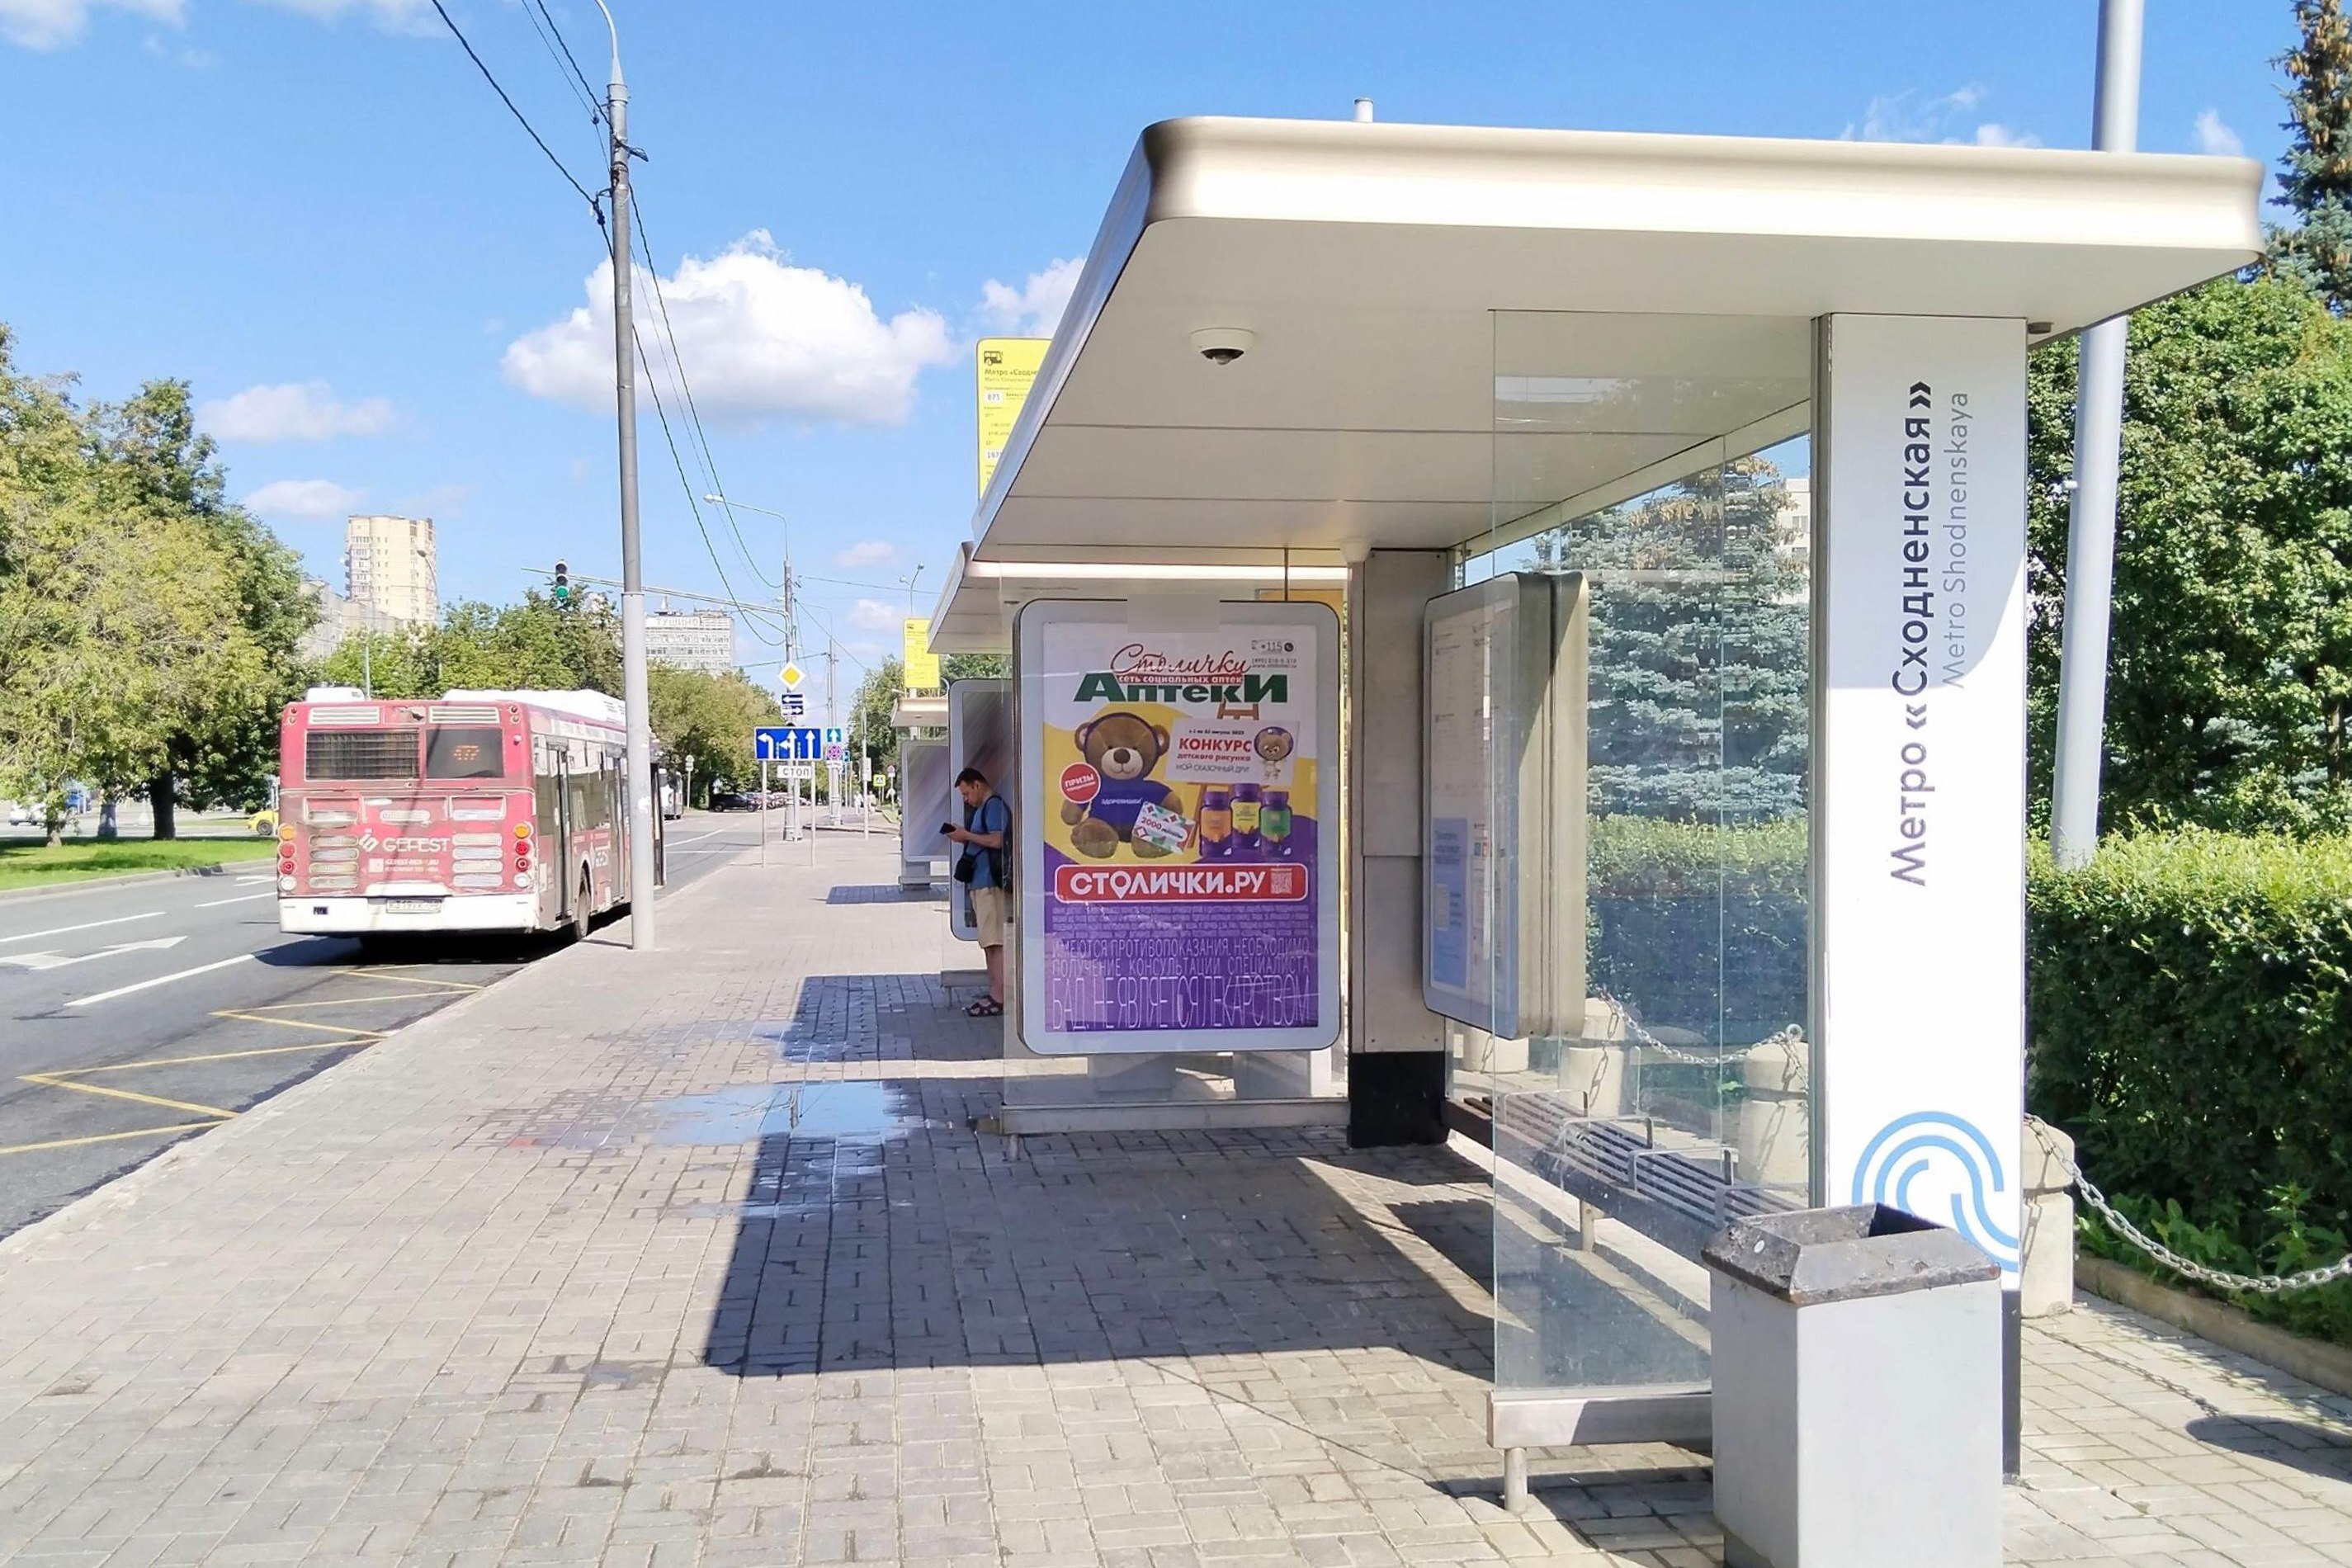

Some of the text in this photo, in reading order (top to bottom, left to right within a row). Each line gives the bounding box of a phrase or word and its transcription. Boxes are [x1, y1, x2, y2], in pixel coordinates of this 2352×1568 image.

[1942, 392, 1974, 690] Metro Shodnenskaya
[1110, 643, 1253, 674] Столички
[1142, 675, 1209, 684] социальных
[1178, 738, 1253, 753] КОНКУРС
[1215, 754, 1252, 763] рисунка
[782, 767, 810, 777] СТОП
[1065, 773, 1094, 788] ПРИЗЫ
[1141, 816, 1162, 831] 2000
[1890, 742, 1936, 887] Метро
[382, 837, 451, 852] GEFEST
[1070, 871, 1266, 900] СТОЛИЧКИ.РУ
[1052, 939, 1108, 958] ИМЕЮТСЯ
[1234, 937, 1310, 956] НЕОБХОДИМО
[1052, 956, 1310, 977] ПОЛУЧЕНИЕ КОНСУЛЬТАЦИИ СПЕЦИАЛИСТА
[1093, 976, 1115, 1029] НЕ
[1117, 975, 1199, 1029] ЯВЛЯЕТСЯ
[1202, 974, 1311, 1028] ЛЕКАРСТВОМ
